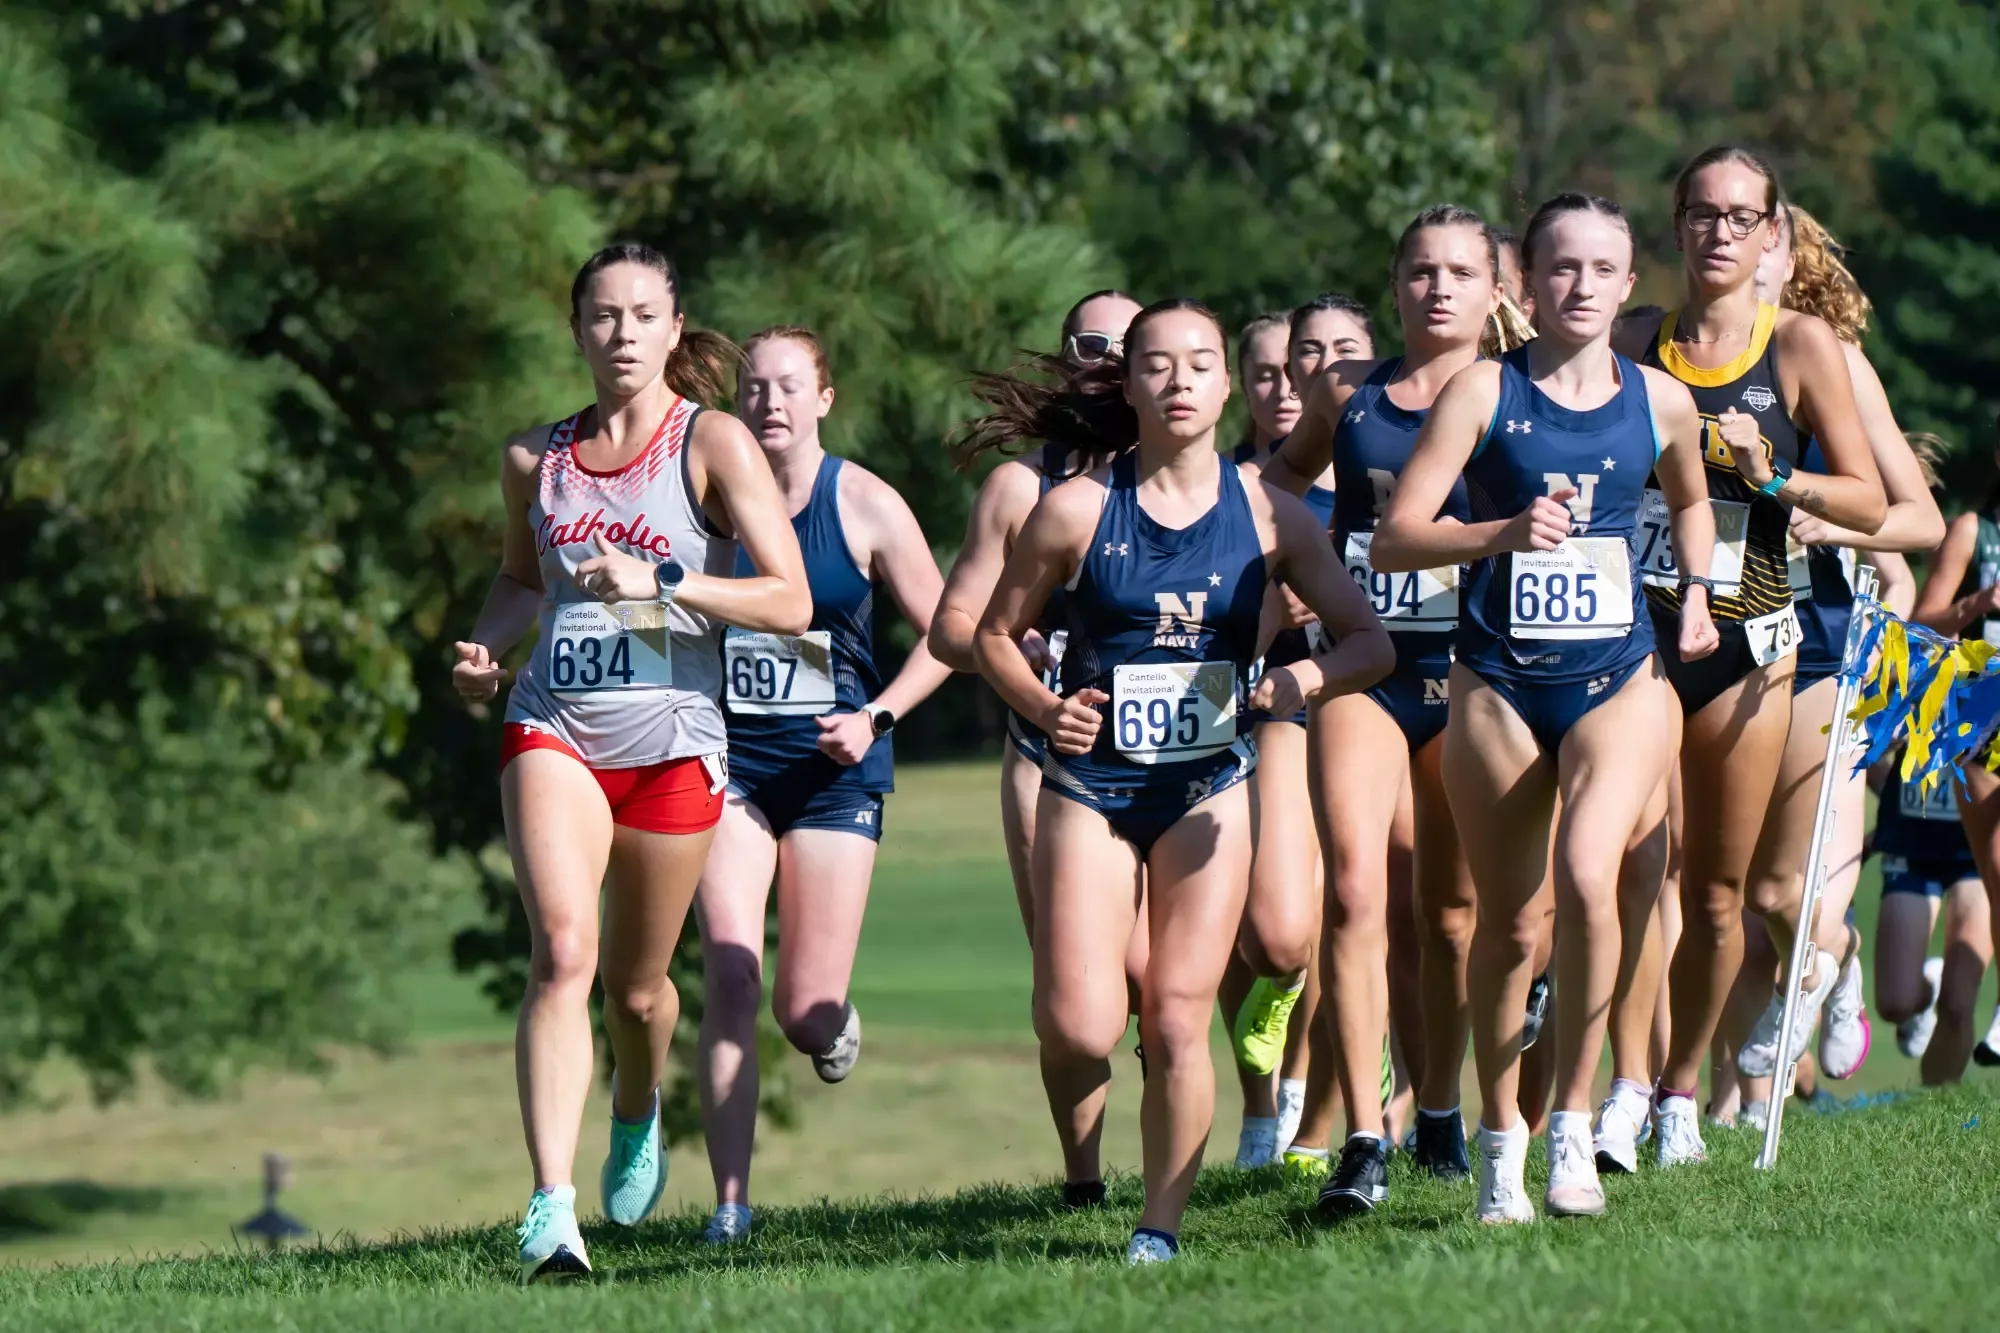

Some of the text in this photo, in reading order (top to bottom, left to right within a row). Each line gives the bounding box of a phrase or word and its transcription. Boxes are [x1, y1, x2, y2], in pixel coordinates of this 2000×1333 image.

[1543, 472, 1600, 522] N
[538, 508, 671, 558] Catholic
[1639, 521, 1677, 572] 73
[1521, 559, 1574, 569] Invitational
[565, 611, 599, 620] Cantello
[1154, 591, 1217, 635] N
[1515, 572, 1597, 623] 685
[559, 623, 607, 632] Invitational
[1154, 634, 1199, 649] NAVY
[1764, 611, 1796, 653] 731
[553, 637, 635, 687] 634
[732, 656, 797, 700] 697
[1128, 673, 1167, 682] Cantello
[1122, 684, 1175, 694] Invitational
[1119, 698, 1200, 749] 695
